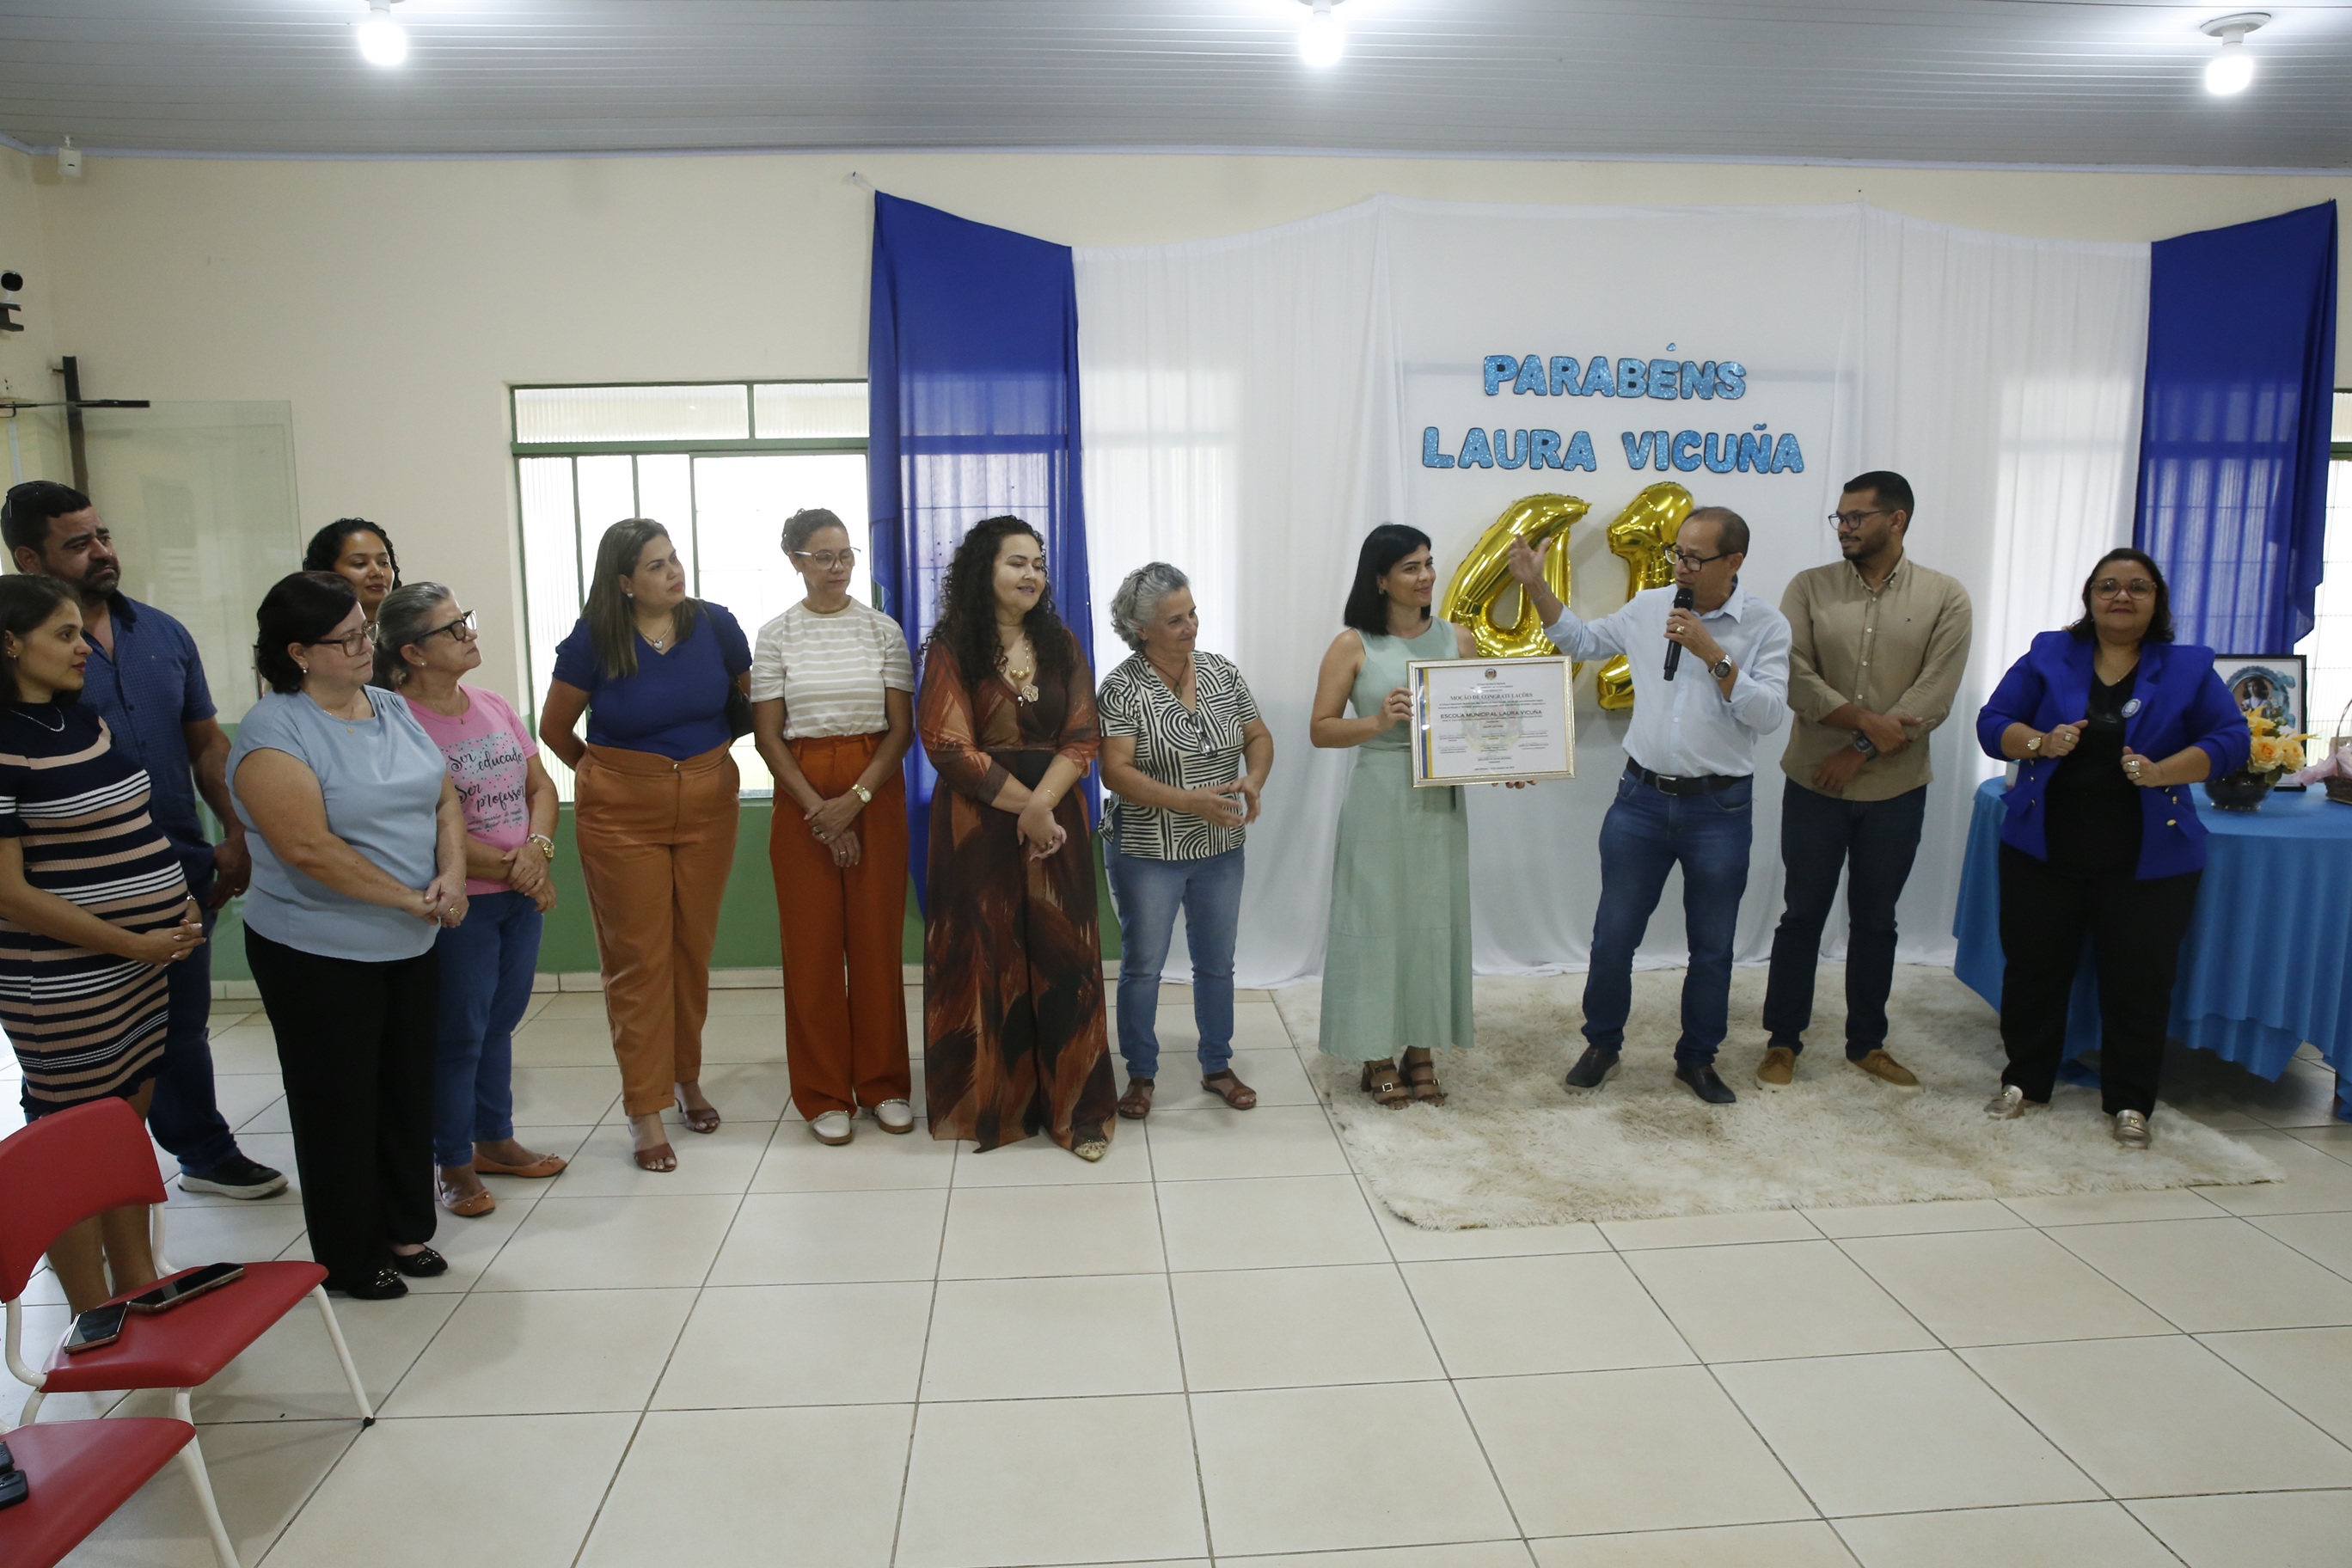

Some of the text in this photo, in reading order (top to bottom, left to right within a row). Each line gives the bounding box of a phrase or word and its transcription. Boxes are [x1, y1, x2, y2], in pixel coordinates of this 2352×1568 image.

[1483, 342, 1747, 401] PARABÉNS
[1422, 423, 1804, 475] LAURA VICUÑA
[448, 753, 476, 772] Ser
[477, 747, 524, 773] educado
[476, 786, 526, 812] professor
